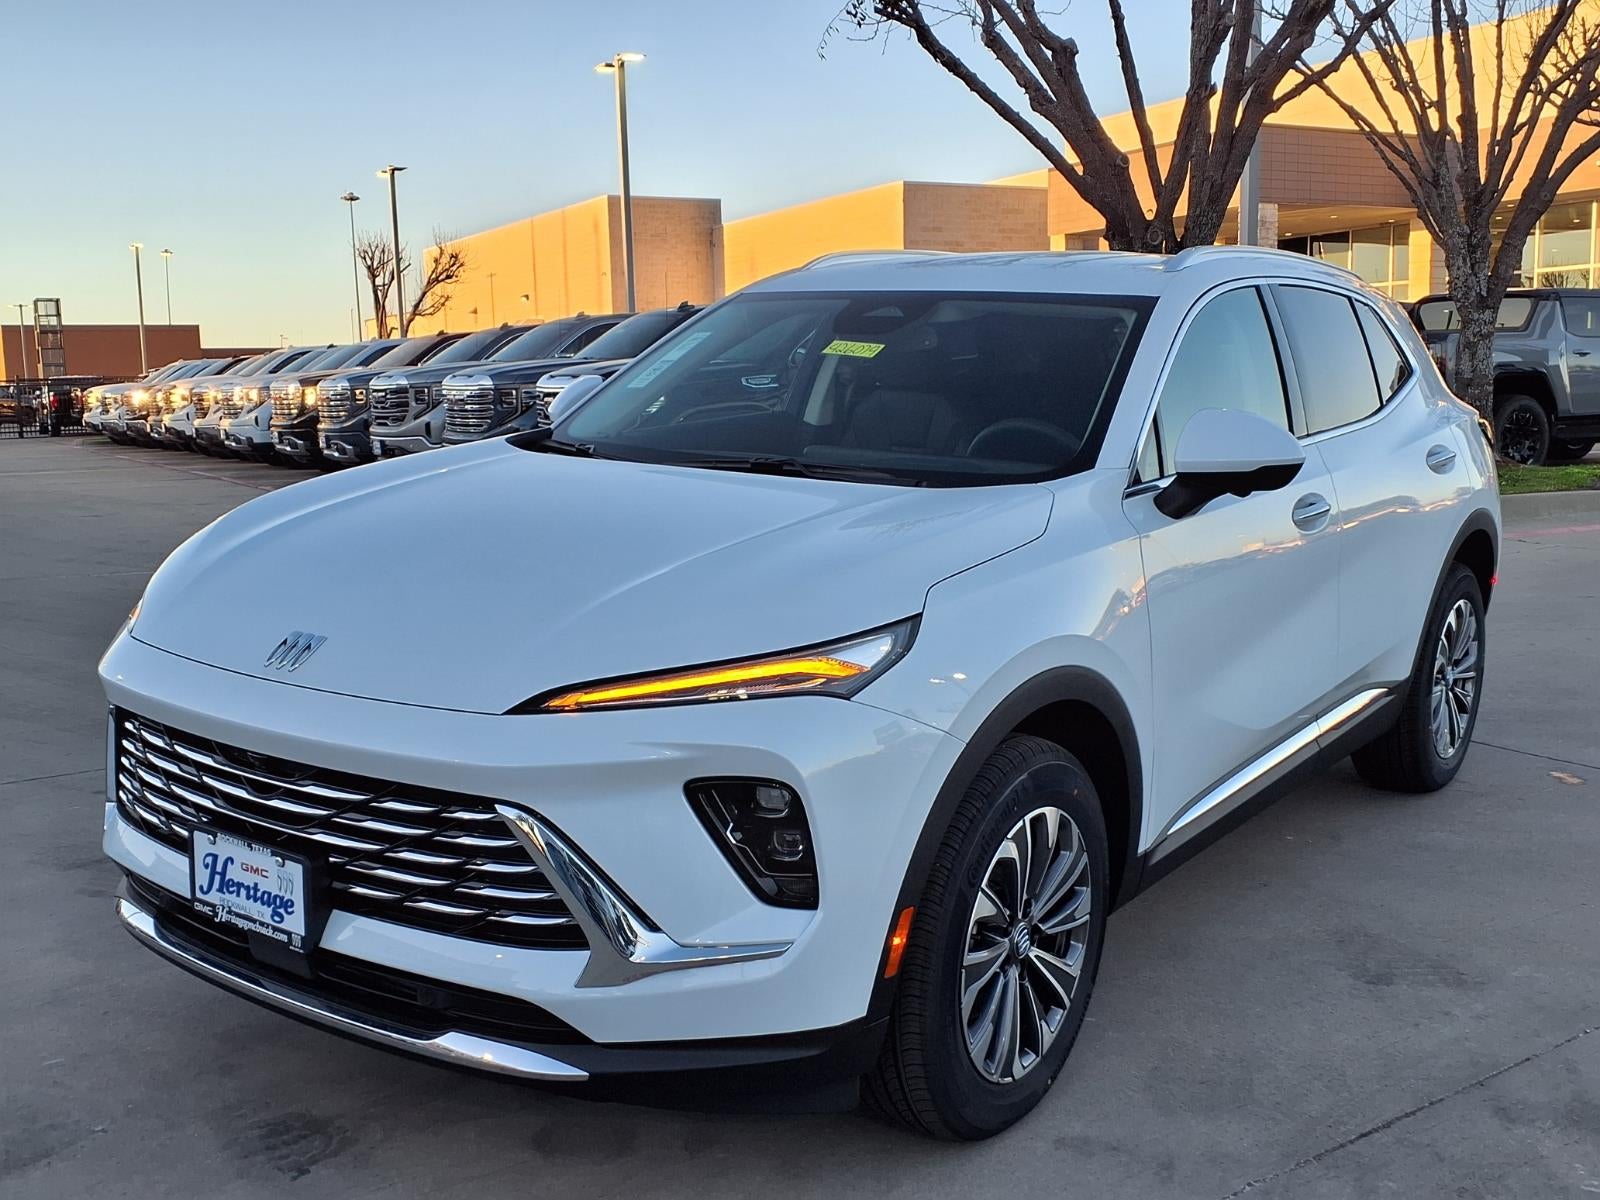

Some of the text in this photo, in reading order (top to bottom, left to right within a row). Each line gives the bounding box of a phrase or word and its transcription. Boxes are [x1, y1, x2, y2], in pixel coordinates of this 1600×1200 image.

[241, 862, 269, 879] GMC
[198, 852, 295, 924] Heritage
[193, 902, 213, 915] GMC
